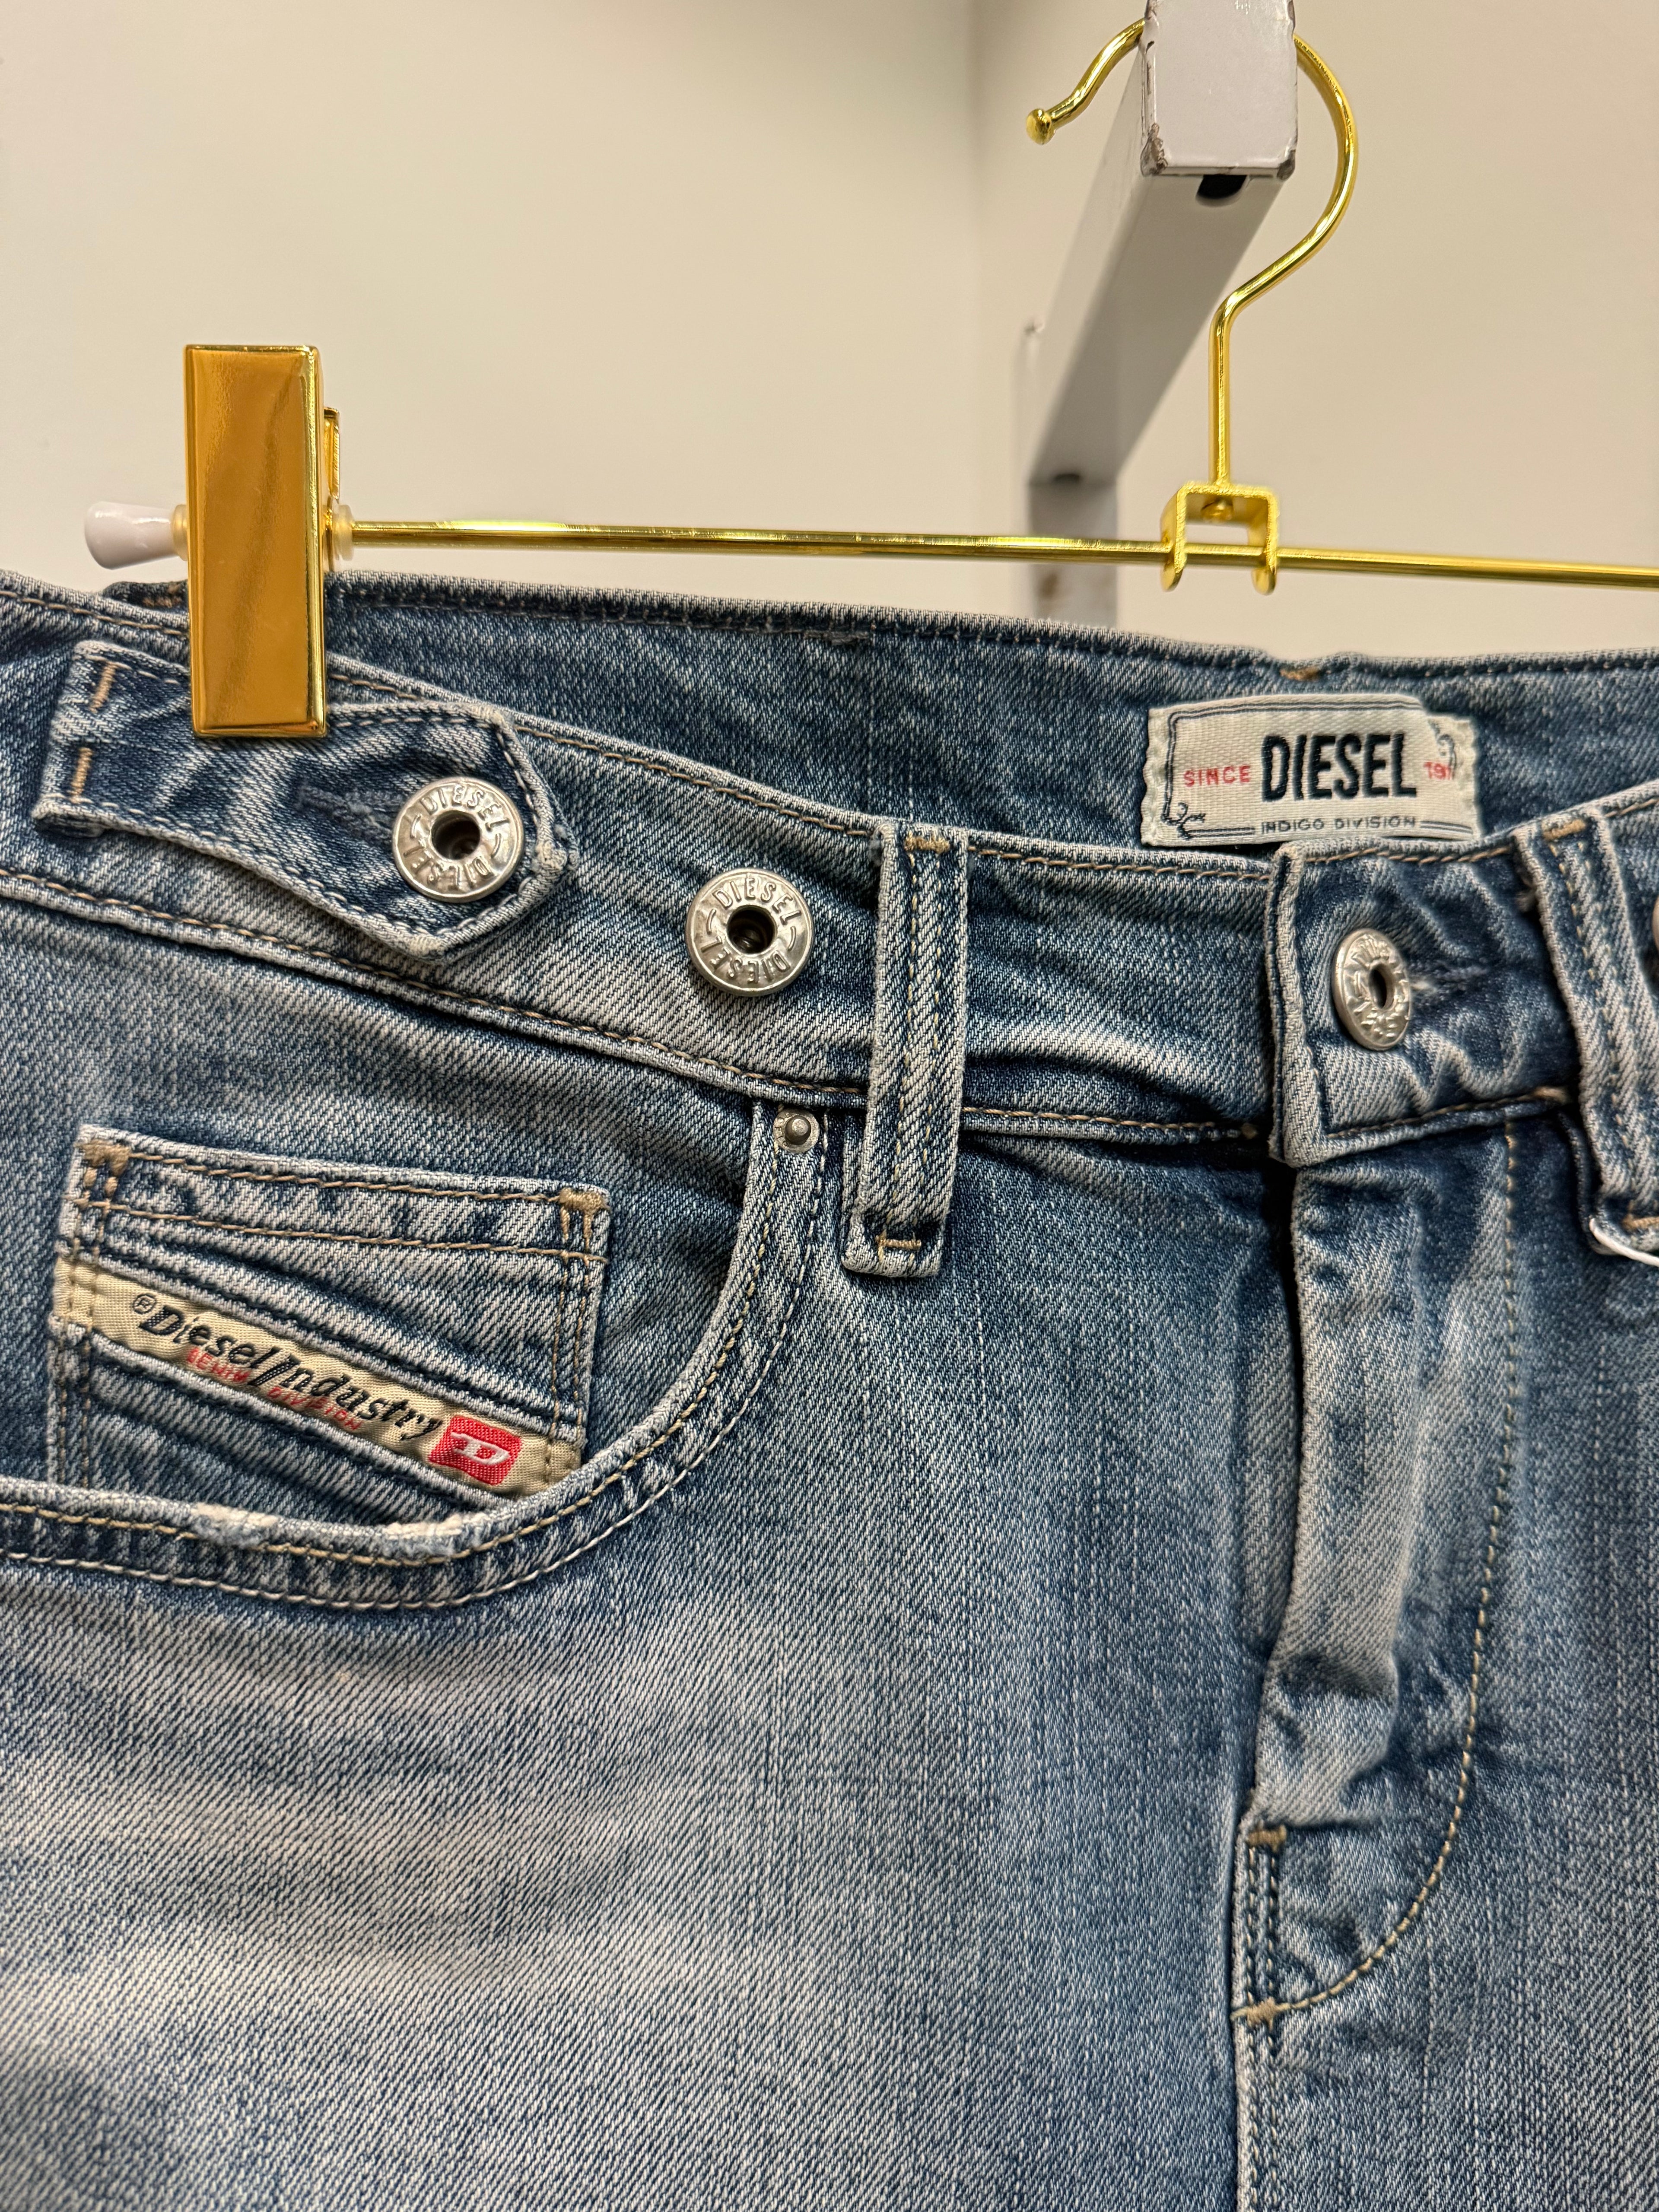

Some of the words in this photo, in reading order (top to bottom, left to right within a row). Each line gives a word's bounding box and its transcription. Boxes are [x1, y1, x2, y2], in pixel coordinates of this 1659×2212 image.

[1183, 765, 1251, 788] SINCE
[1262, 732, 1417, 802] DIESEL
[420, 784, 510, 833] DIESEL
[1261, 818, 1325, 835] INDIGO
[1334, 815, 1415, 830] DIVISION
[712, 877, 802, 925] DIESEL
[138, 1305, 281, 1369] Diesel
[247, 1353, 443, 1441] Industry
